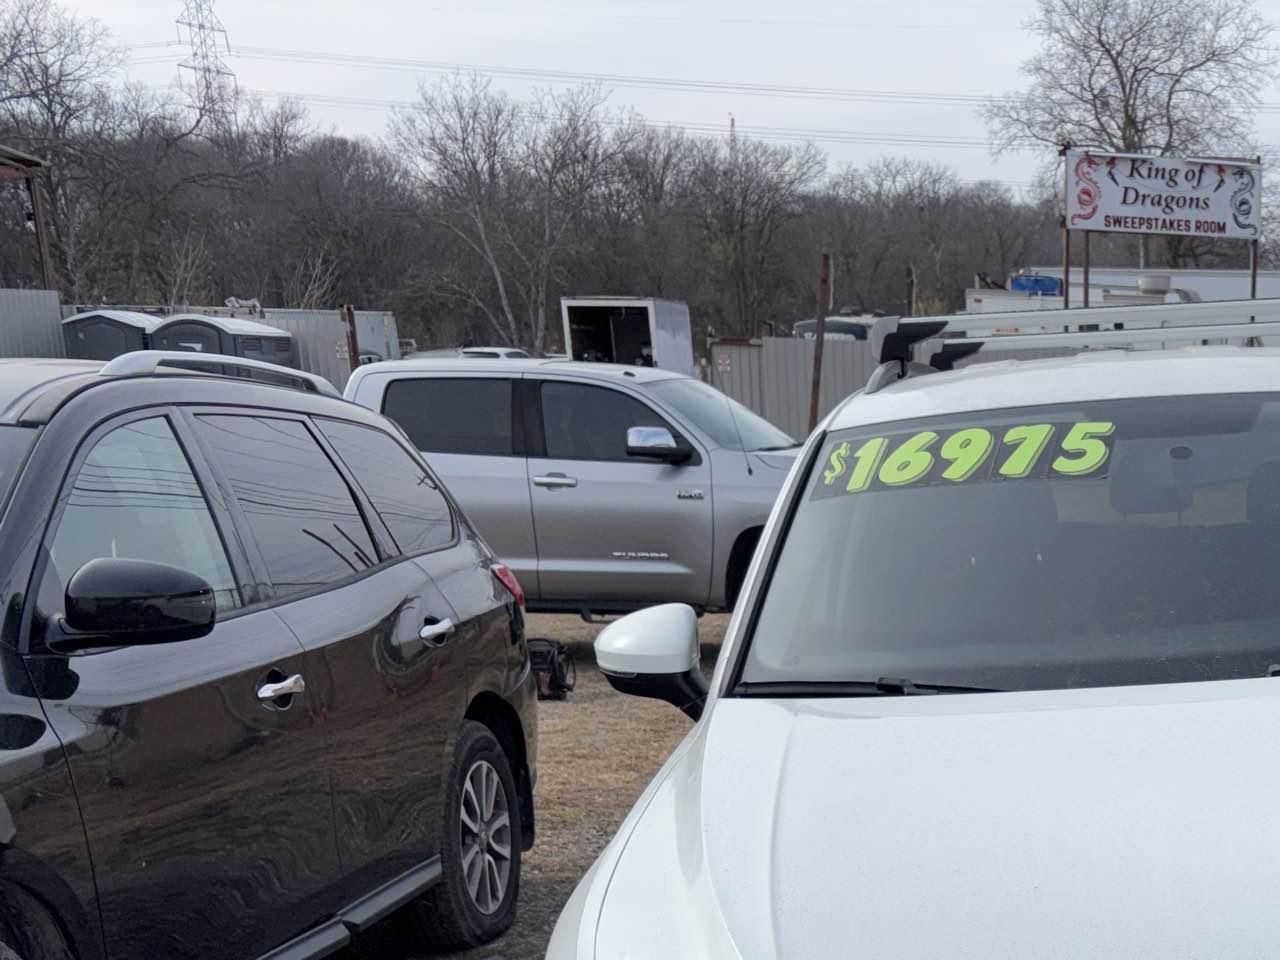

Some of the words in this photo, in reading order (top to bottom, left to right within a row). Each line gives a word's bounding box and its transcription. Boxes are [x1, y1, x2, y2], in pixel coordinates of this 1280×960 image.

[1128, 159, 1179, 187] King
[1184, 162, 1208, 189] of
[1120, 186, 1210, 214] Dragons
[1104, 215, 1191, 232] SWEEPSTAKES
[1195, 220, 1226, 234] ROOM
[823, 421, 1116, 494] $16975
